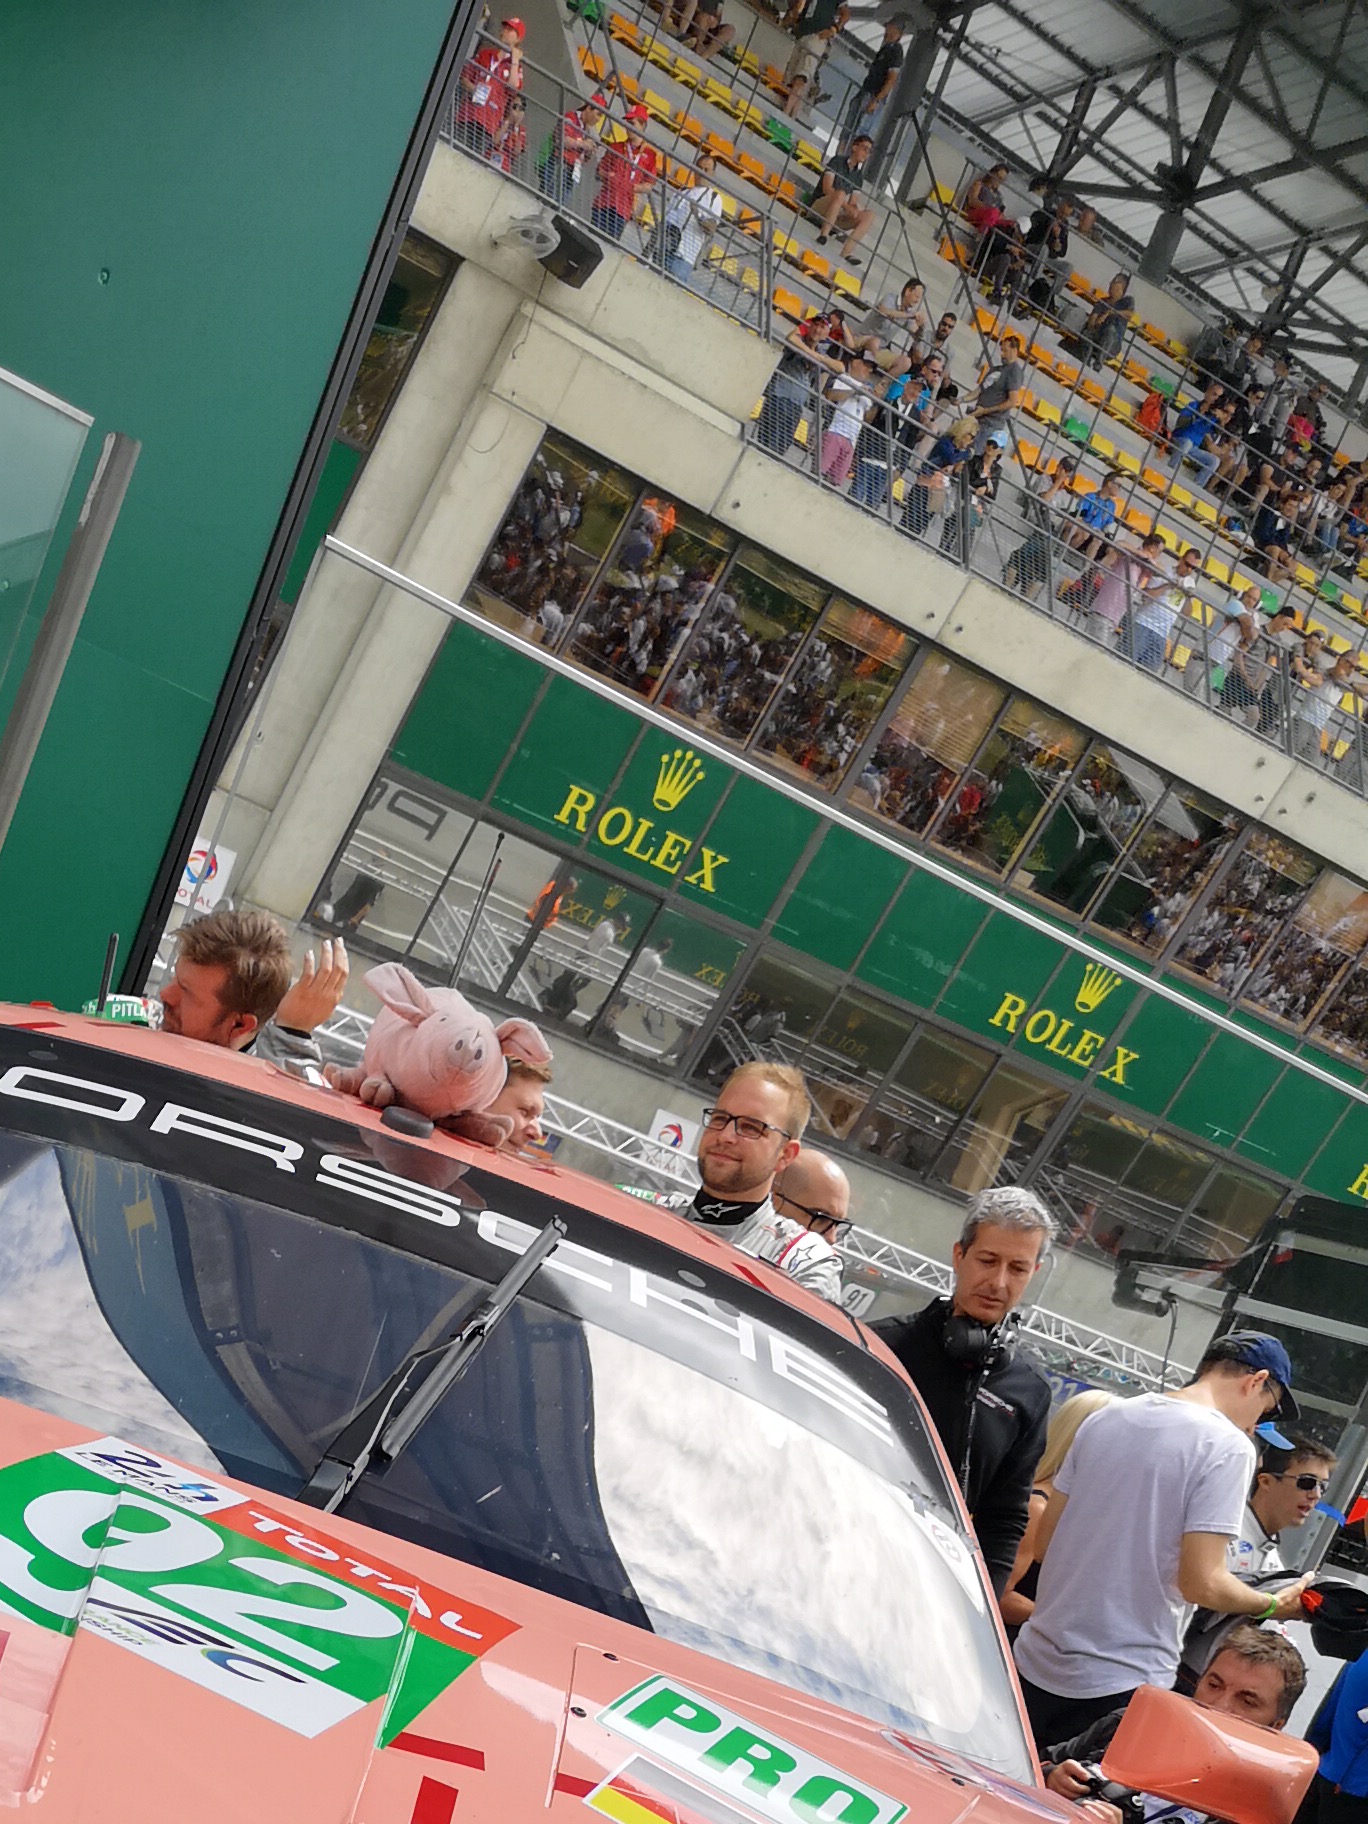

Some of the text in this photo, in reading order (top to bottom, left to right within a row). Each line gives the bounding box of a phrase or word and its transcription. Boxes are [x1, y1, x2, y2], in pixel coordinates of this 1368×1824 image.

[554, 784, 730, 892] ROLEX
[988, 993, 1140, 1087] ROLEX
[842, 1289, 869, 1311] 91
[112, 1469, 199, 1504] MANS
[245, 1510, 483, 1640] TOTAL
